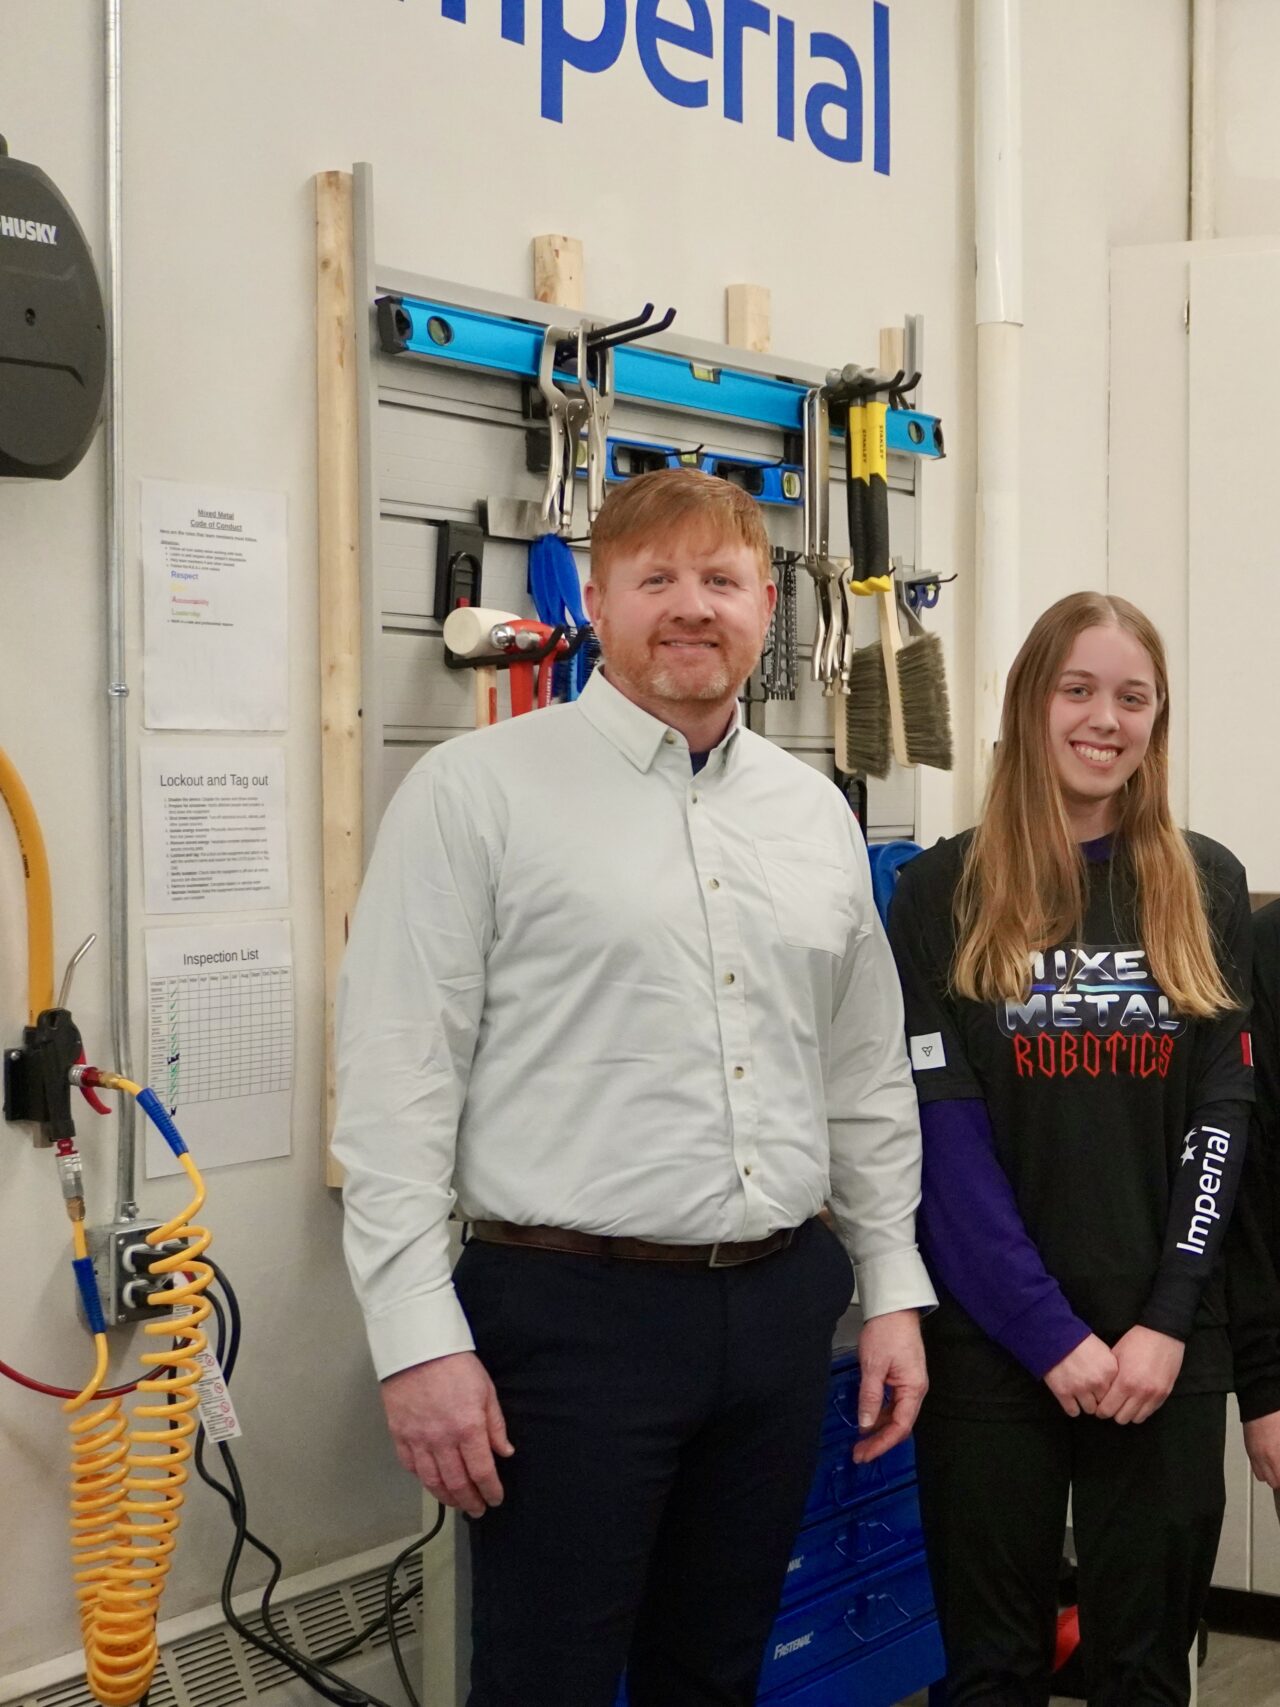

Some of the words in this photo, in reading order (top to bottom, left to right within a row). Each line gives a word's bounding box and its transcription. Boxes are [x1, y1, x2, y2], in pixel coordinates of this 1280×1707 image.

[398, 0, 891, 176] perial
[1, 215, 57, 245] HUSKY
[190, 519, 207, 528] Code
[216, 522, 243, 532] Conduct
[198, 509, 216, 519] Mixed
[218, 511, 234, 521] Metal
[160, 774, 204, 787] Lockout
[206, 774, 227, 787] and
[230, 774, 249, 789] Tag
[252, 775, 269, 787] out
[183, 950, 238, 968] Inspection
[241, 948, 259, 961] List
[1028, 947, 1149, 982] IXE
[1012, 1030, 1174, 1078] ROBOTICS
[1176, 1125, 1231, 1255] Imperial
[773, 1633, 813, 1660] FASTENAL
